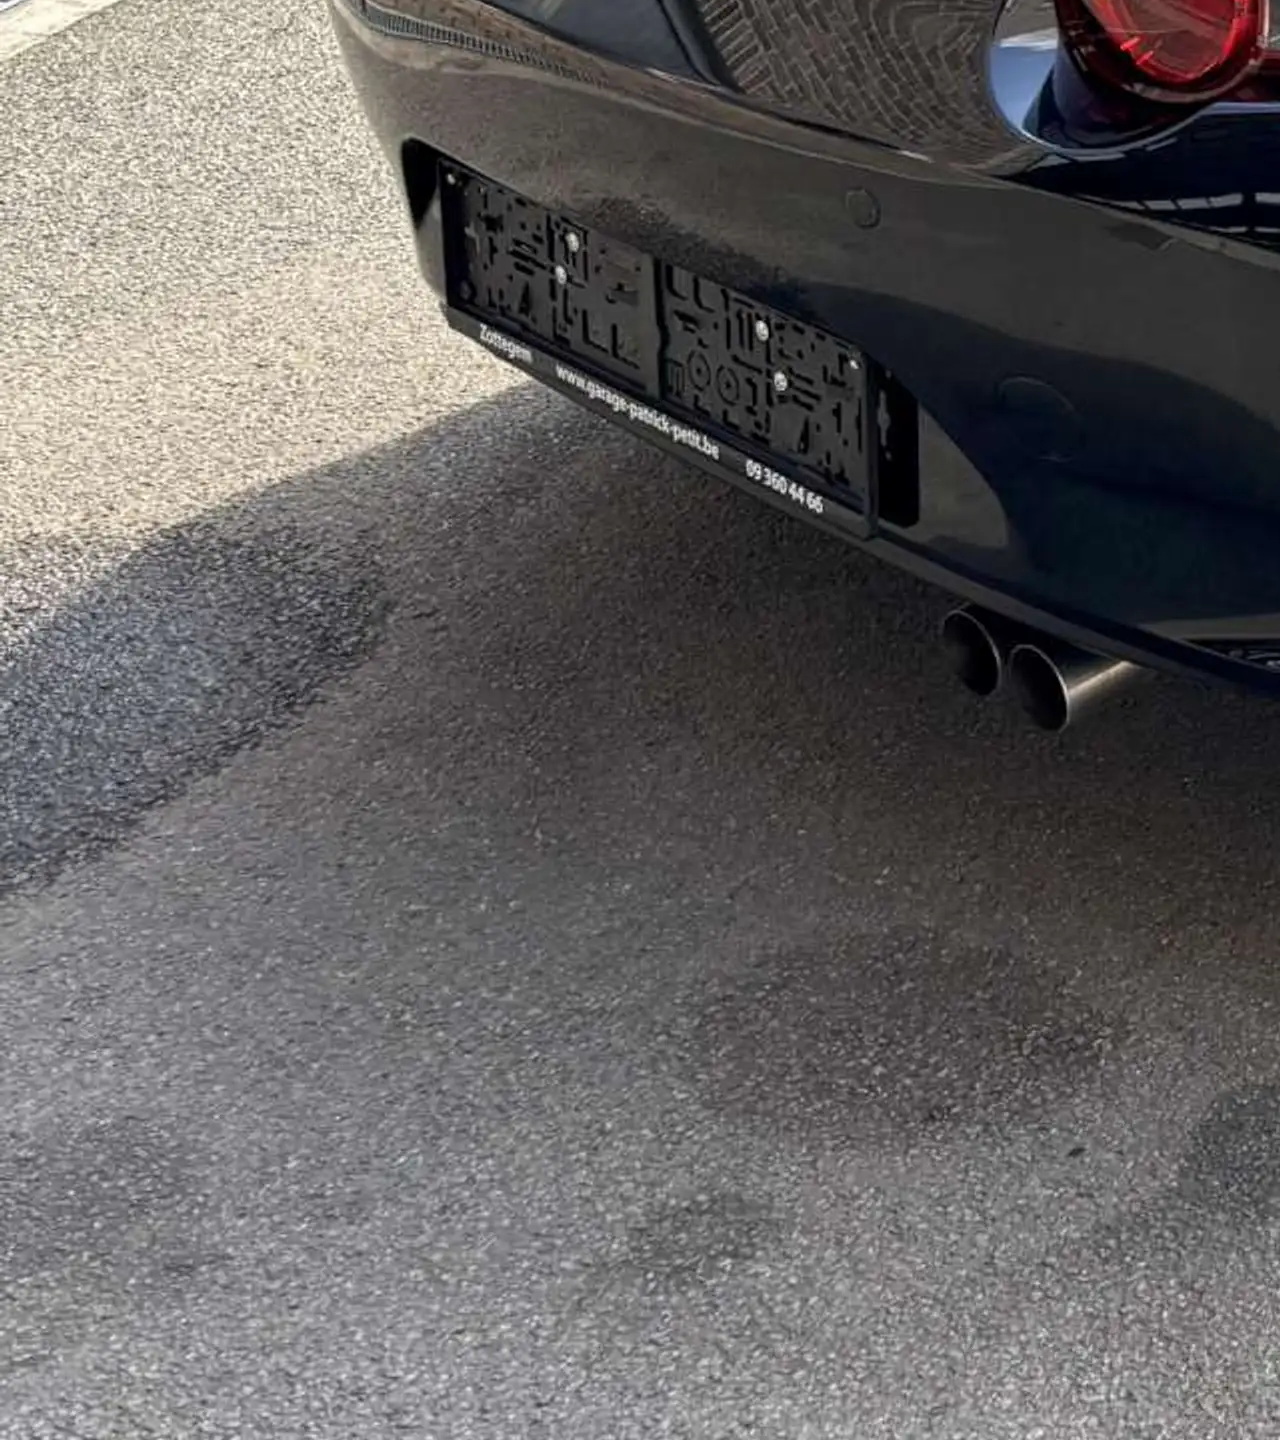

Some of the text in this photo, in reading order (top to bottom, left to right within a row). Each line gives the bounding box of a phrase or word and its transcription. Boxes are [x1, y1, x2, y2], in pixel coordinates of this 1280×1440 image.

[479, 323, 824, 513] Zottegem www.garage-patrick-petit.be 09 360 44 66
